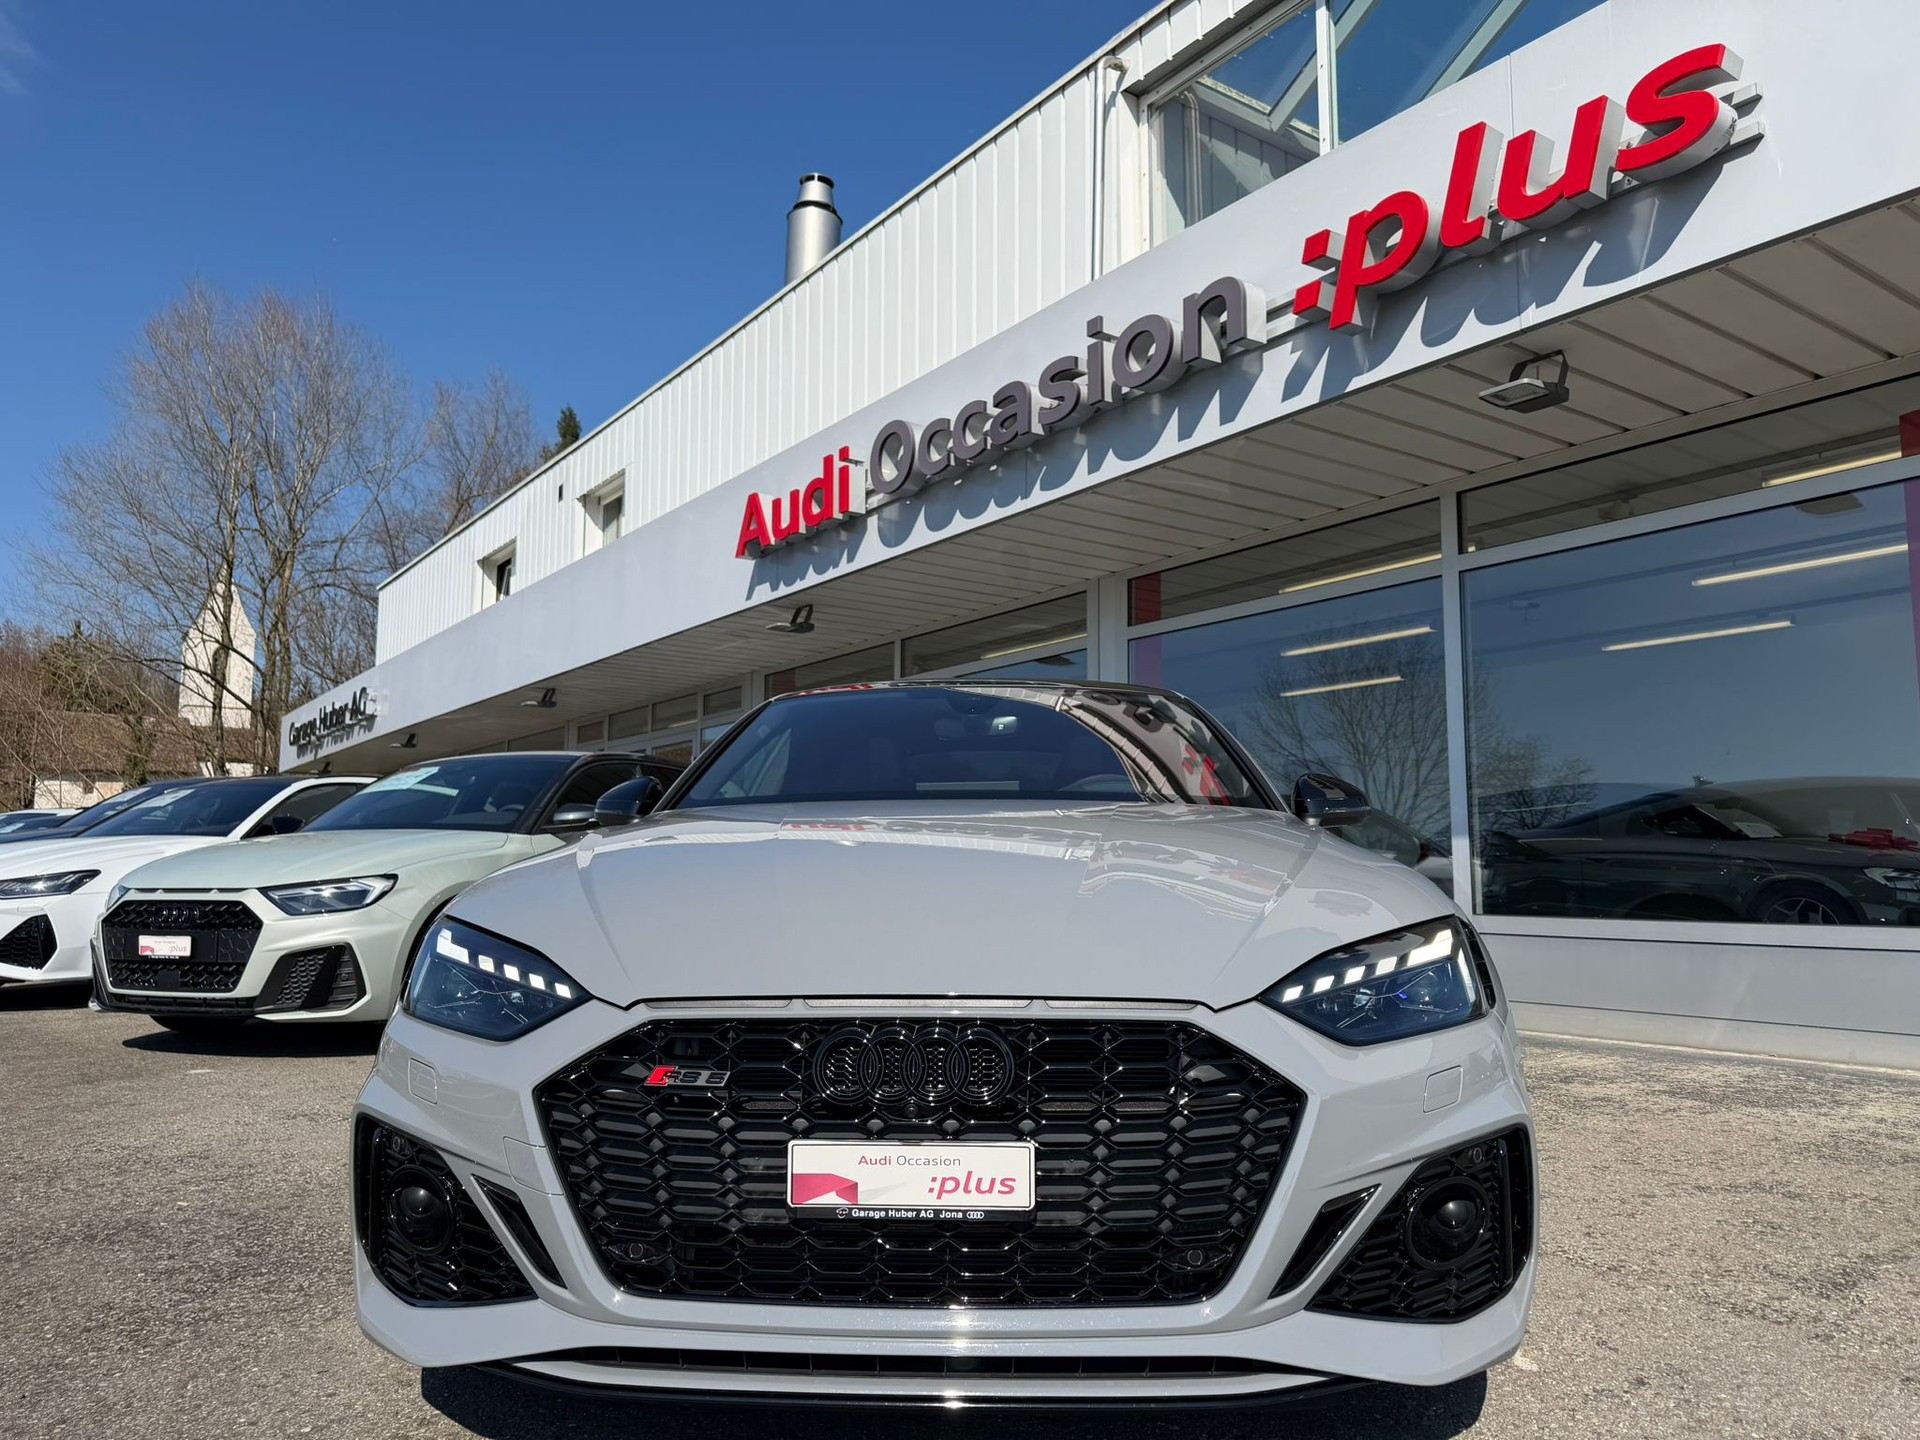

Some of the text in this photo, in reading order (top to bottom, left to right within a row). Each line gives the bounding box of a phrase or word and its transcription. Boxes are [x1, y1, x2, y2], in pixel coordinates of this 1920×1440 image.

[735, 43, 1728, 558] Audi Occasion :plus
[288, 686, 370, 746] Garage Huber AG
[858, 1155, 961, 1167] Audi Occasion
[928, 1171, 1016, 1200] :plus
[852, 1209, 963, 1220] Garage Huber AG Jona
